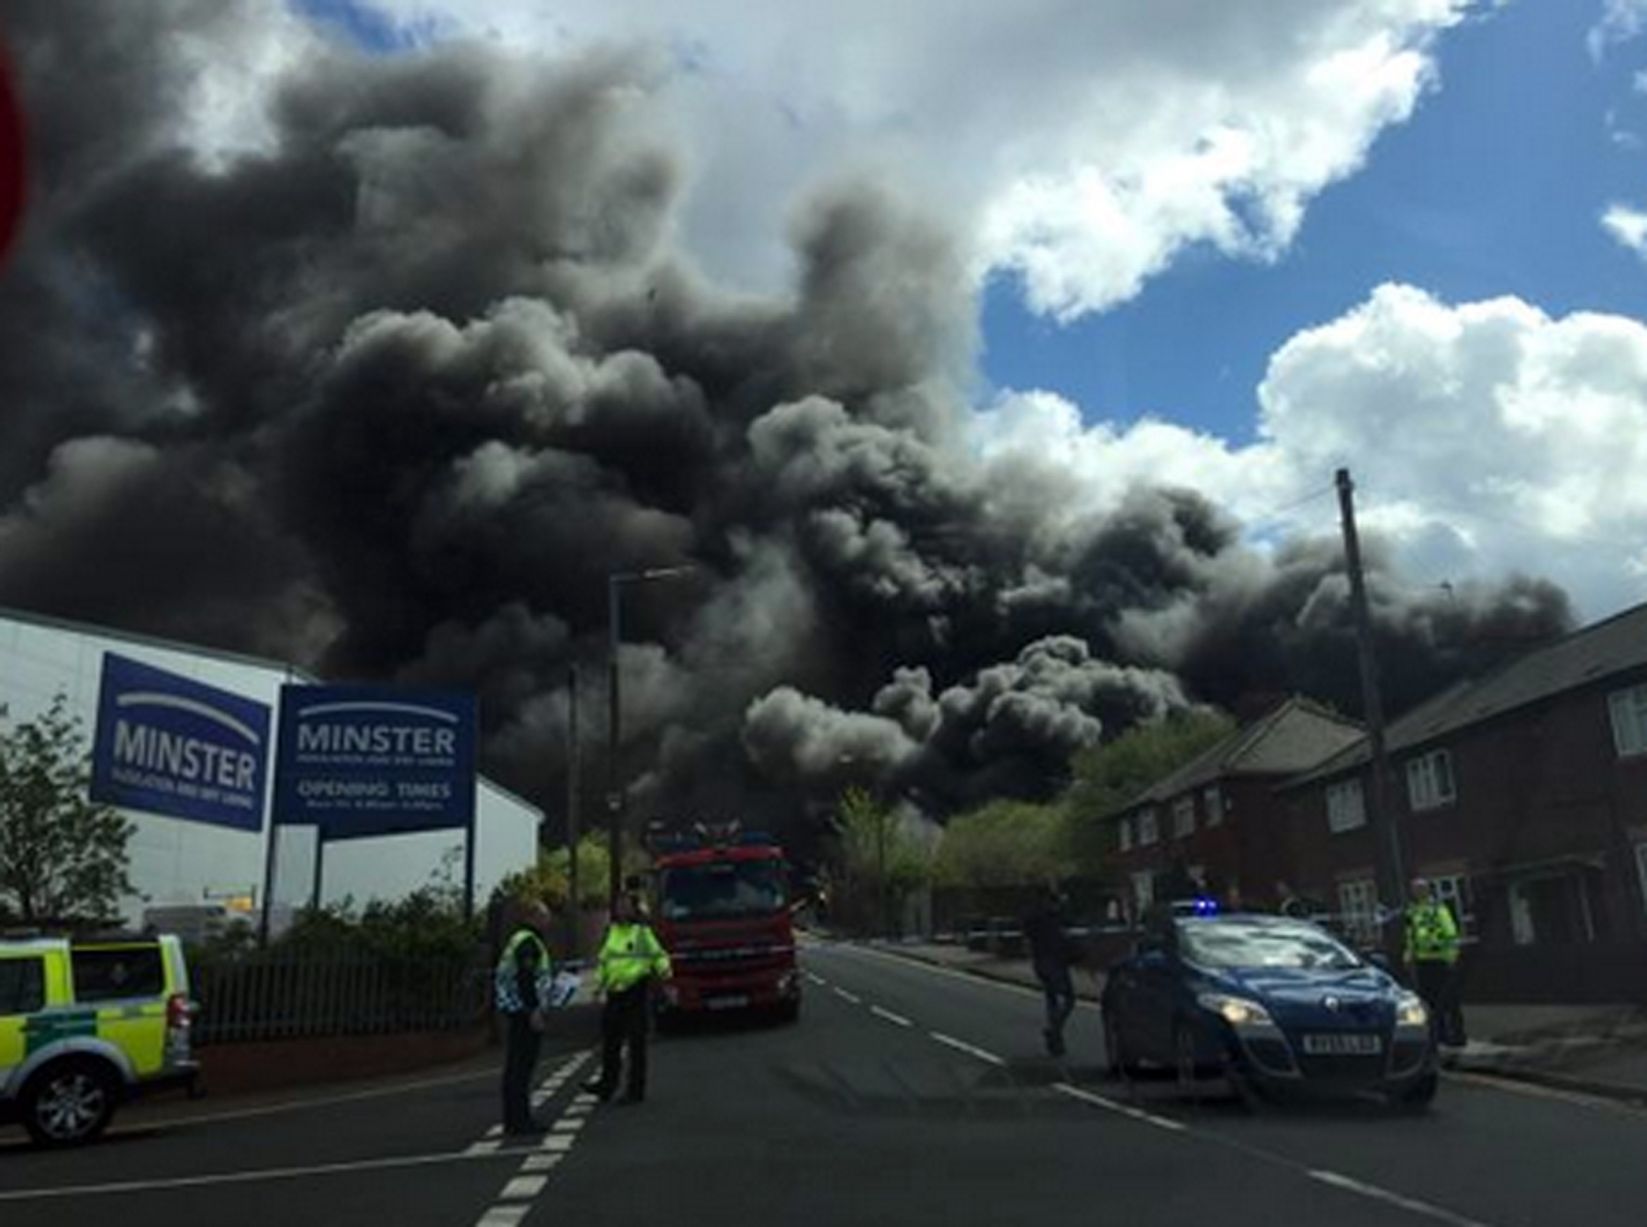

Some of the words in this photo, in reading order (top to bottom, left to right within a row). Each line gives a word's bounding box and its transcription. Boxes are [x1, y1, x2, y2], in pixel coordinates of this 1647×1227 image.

[297, 724, 457, 755] MINSTER
[113, 719, 258, 792] MINSTER
[297, 780, 390, 797] OPENING
[396, 782, 452, 798] TIMES
